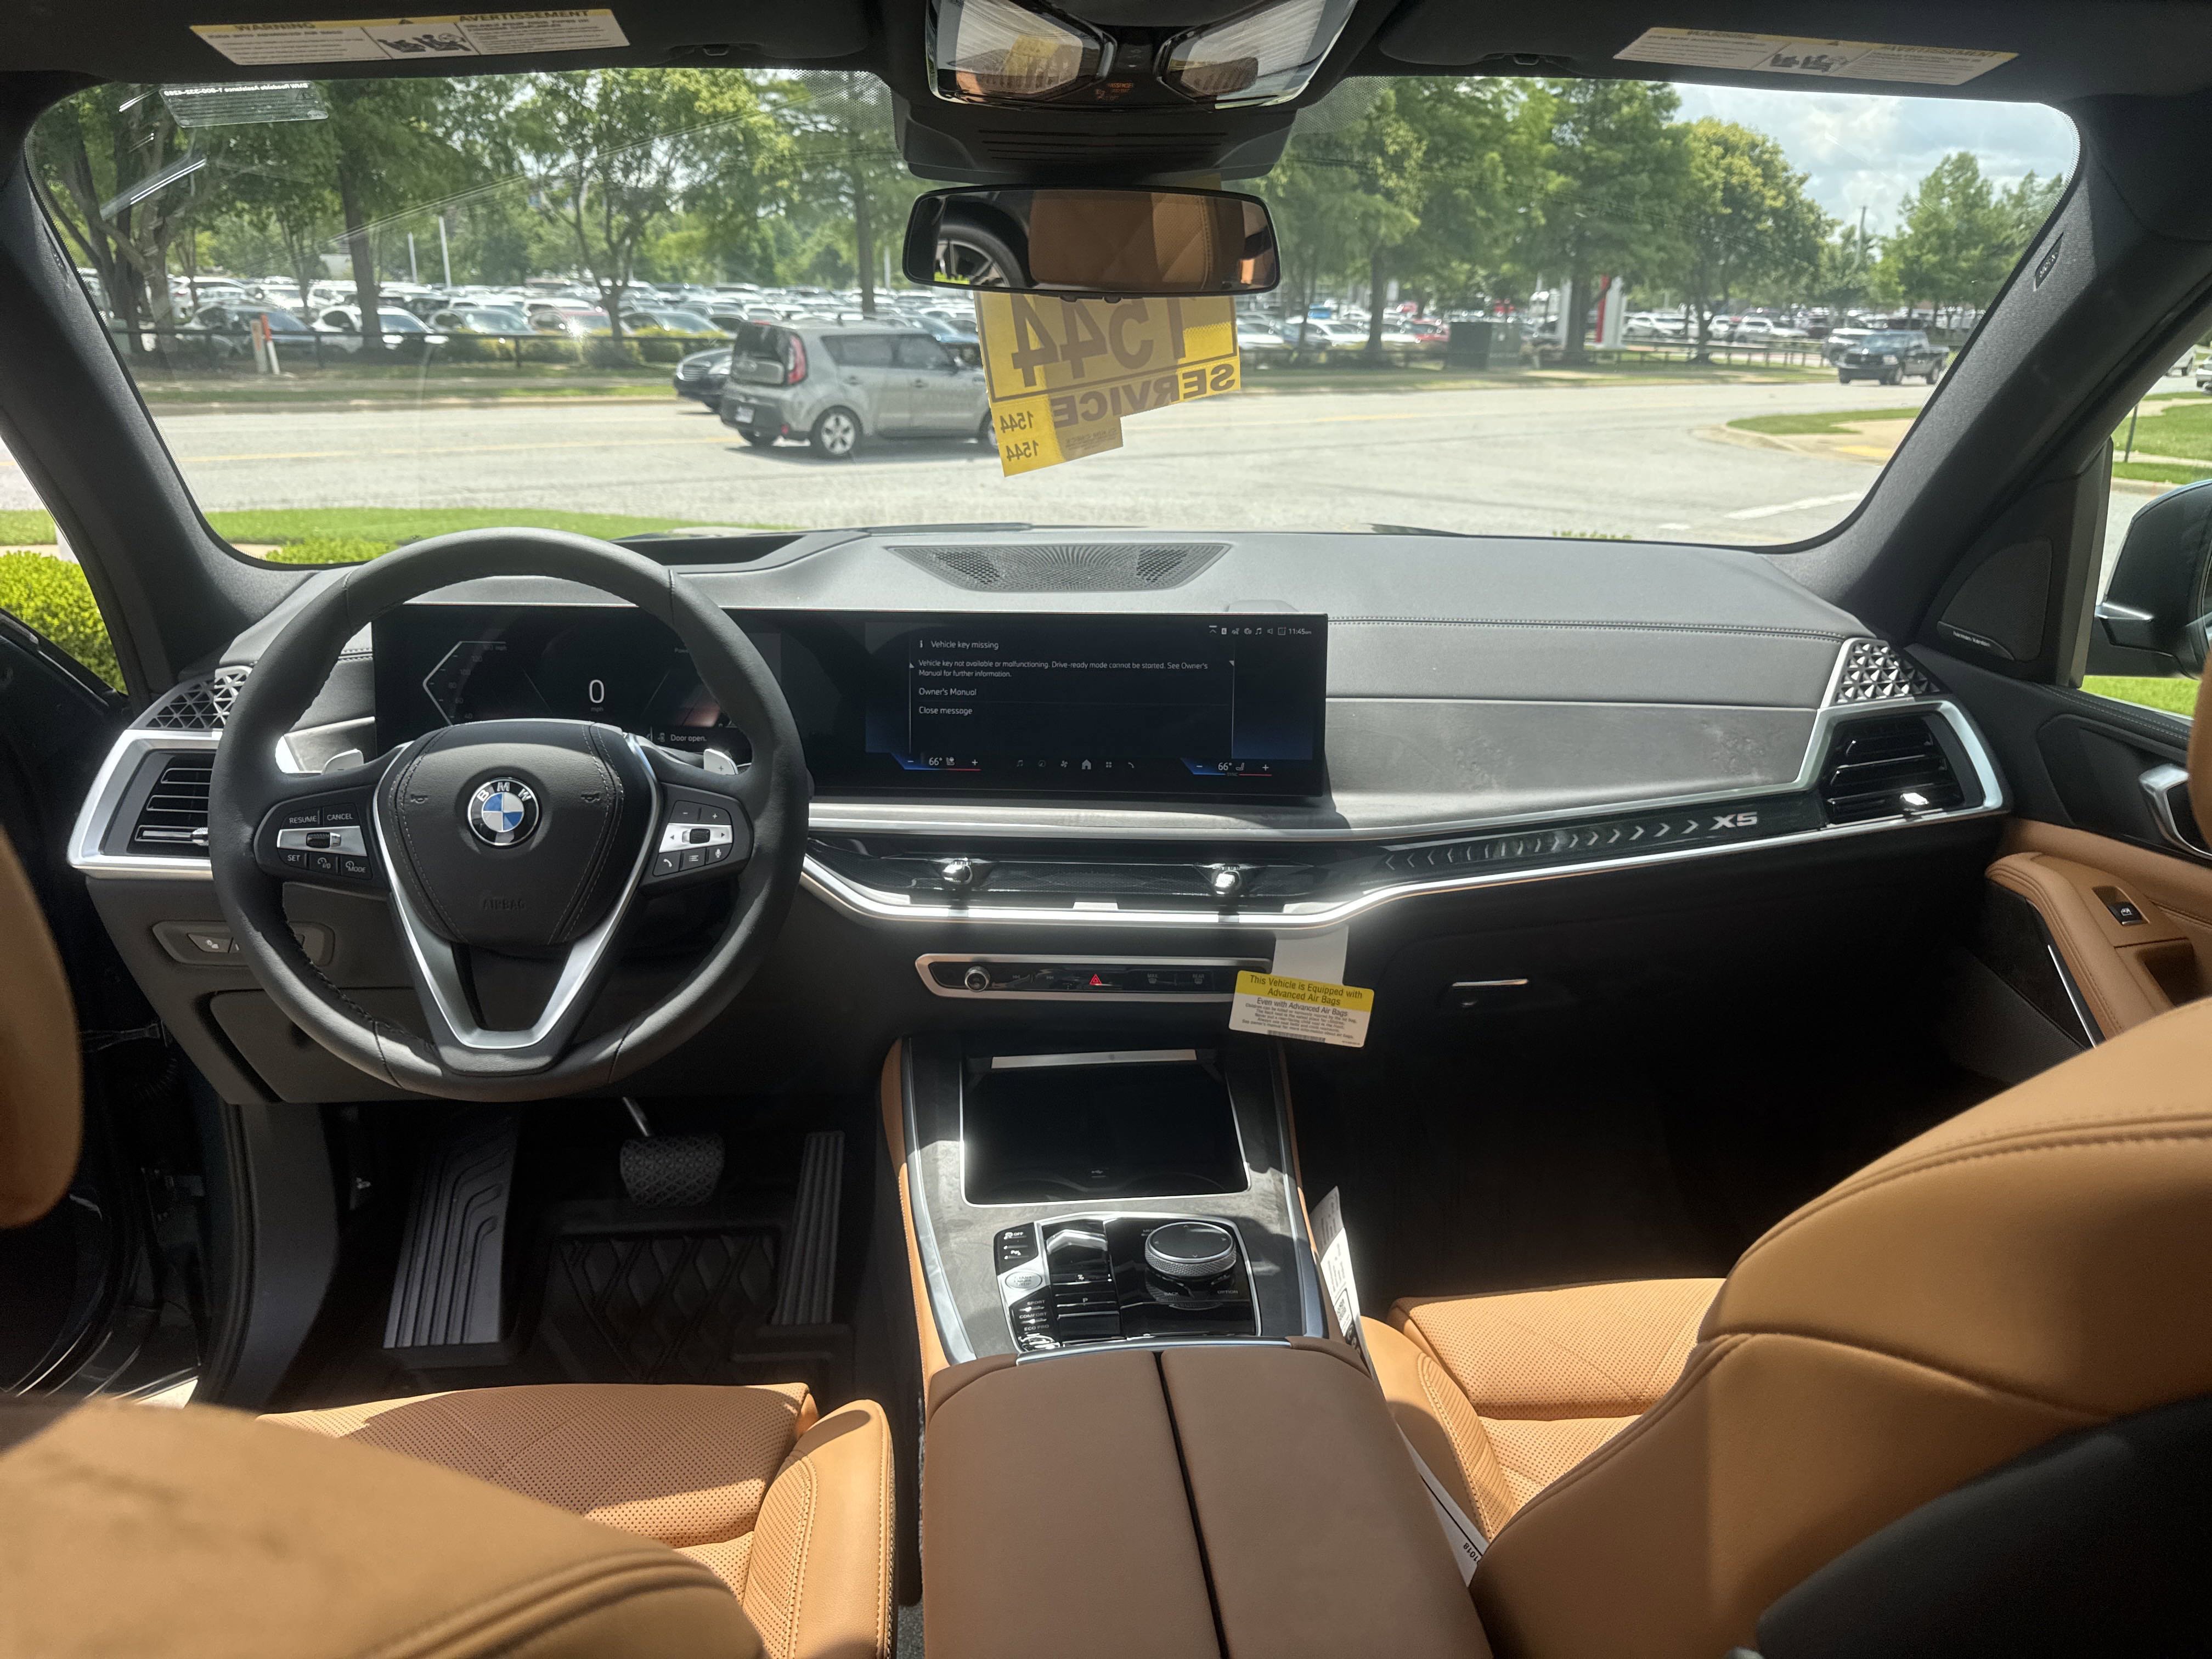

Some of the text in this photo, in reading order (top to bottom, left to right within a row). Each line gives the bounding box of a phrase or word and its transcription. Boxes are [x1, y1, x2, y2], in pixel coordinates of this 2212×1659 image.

[958, 641, 970, 650] key
[972, 641, 999, 650] missing
[943, 660, 953, 668] key
[1002, 661, 1050, 669] malfunctioning.
[1052, 661, 1088, 669] Drive-ready
[589, 679, 605, 703] 0
[477, 781, 532, 802] BMW
[289, 815, 317, 823] RESUME
[1709, 812, 1758, 831] X5
[1250, 974, 1363, 999] This Vehicle is Equipped with
[1267, 988, 1341, 1006] Advanced Air Bags
[1257, 997, 1272, 1006] Even
[1274, 999, 1288, 1008] with
[1289, 1002, 1321, 1013] Advanced
[1321, 1006, 1331, 1014] Air
[1332, 1007, 1348, 1017] Bags
